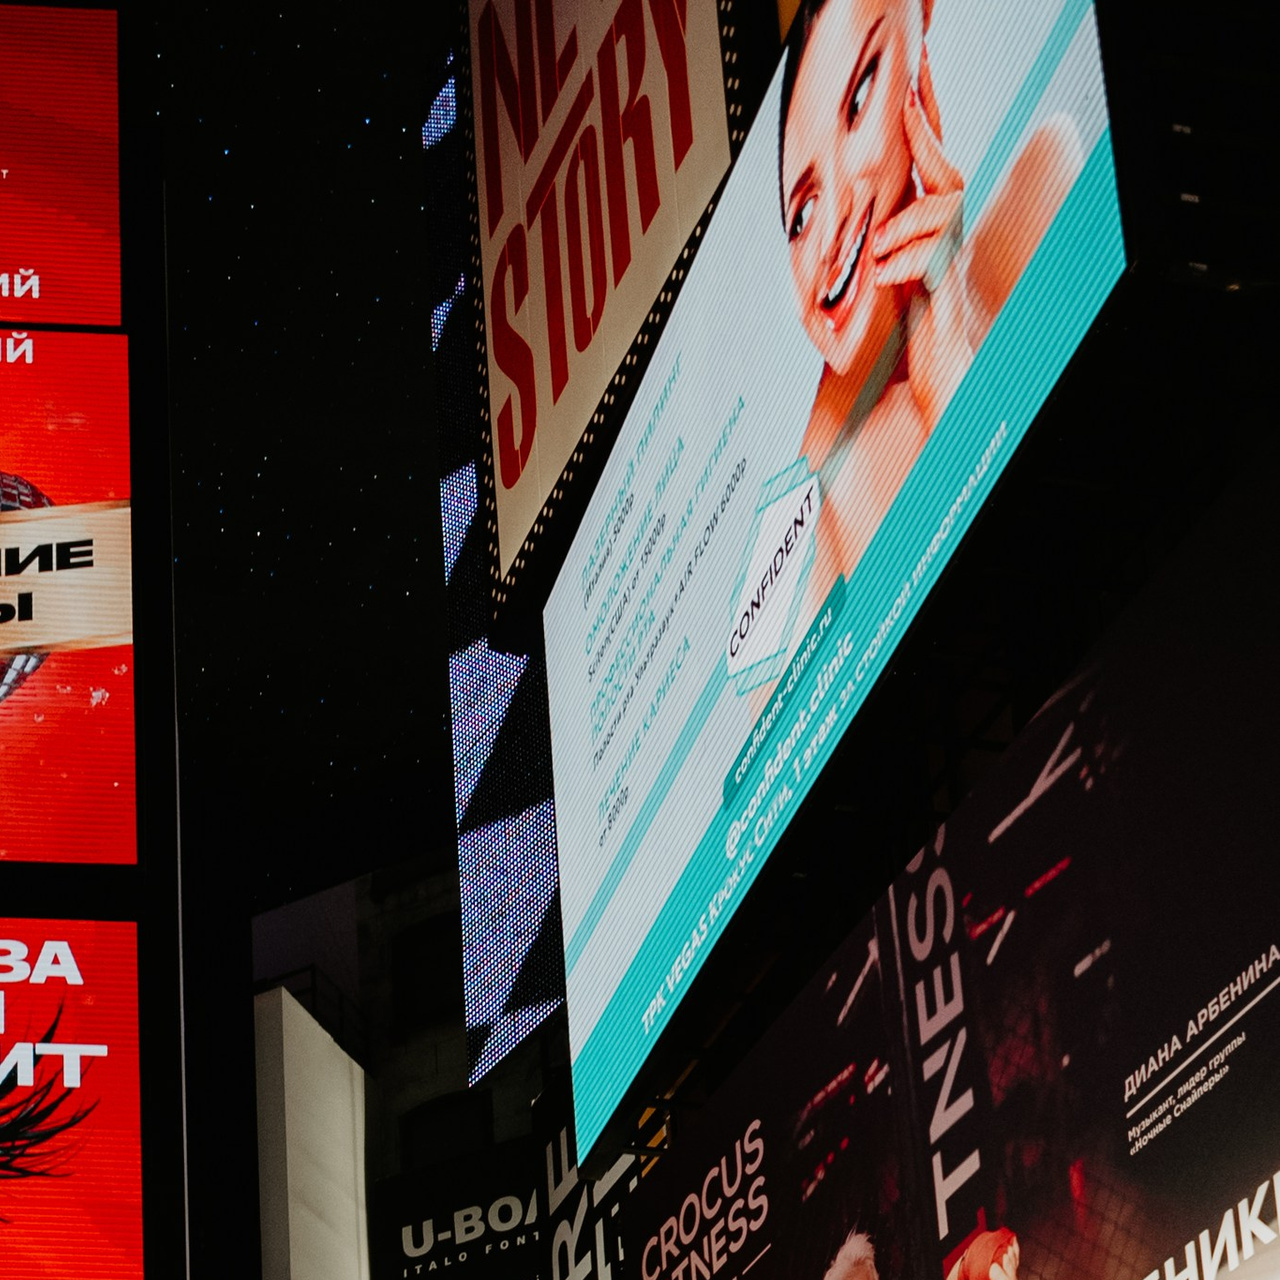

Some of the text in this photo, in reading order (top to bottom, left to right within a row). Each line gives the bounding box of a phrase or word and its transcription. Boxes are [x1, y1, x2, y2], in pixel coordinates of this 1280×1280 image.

[729, 485, 816, 658] CONFIDENT
[734, 607, 832, 784] confident-clinic.ru
[725, 631, 854, 861] @confident.clinic
[665, 913, 708, 994] VEGAS
[1124, 1035, 1182, 1103] ДИАНА
[1176, 1066, 1207, 1099] лидер
[1208, 1032, 1246, 1071] группы
[403, 1252, 467, 1278] ITALO
